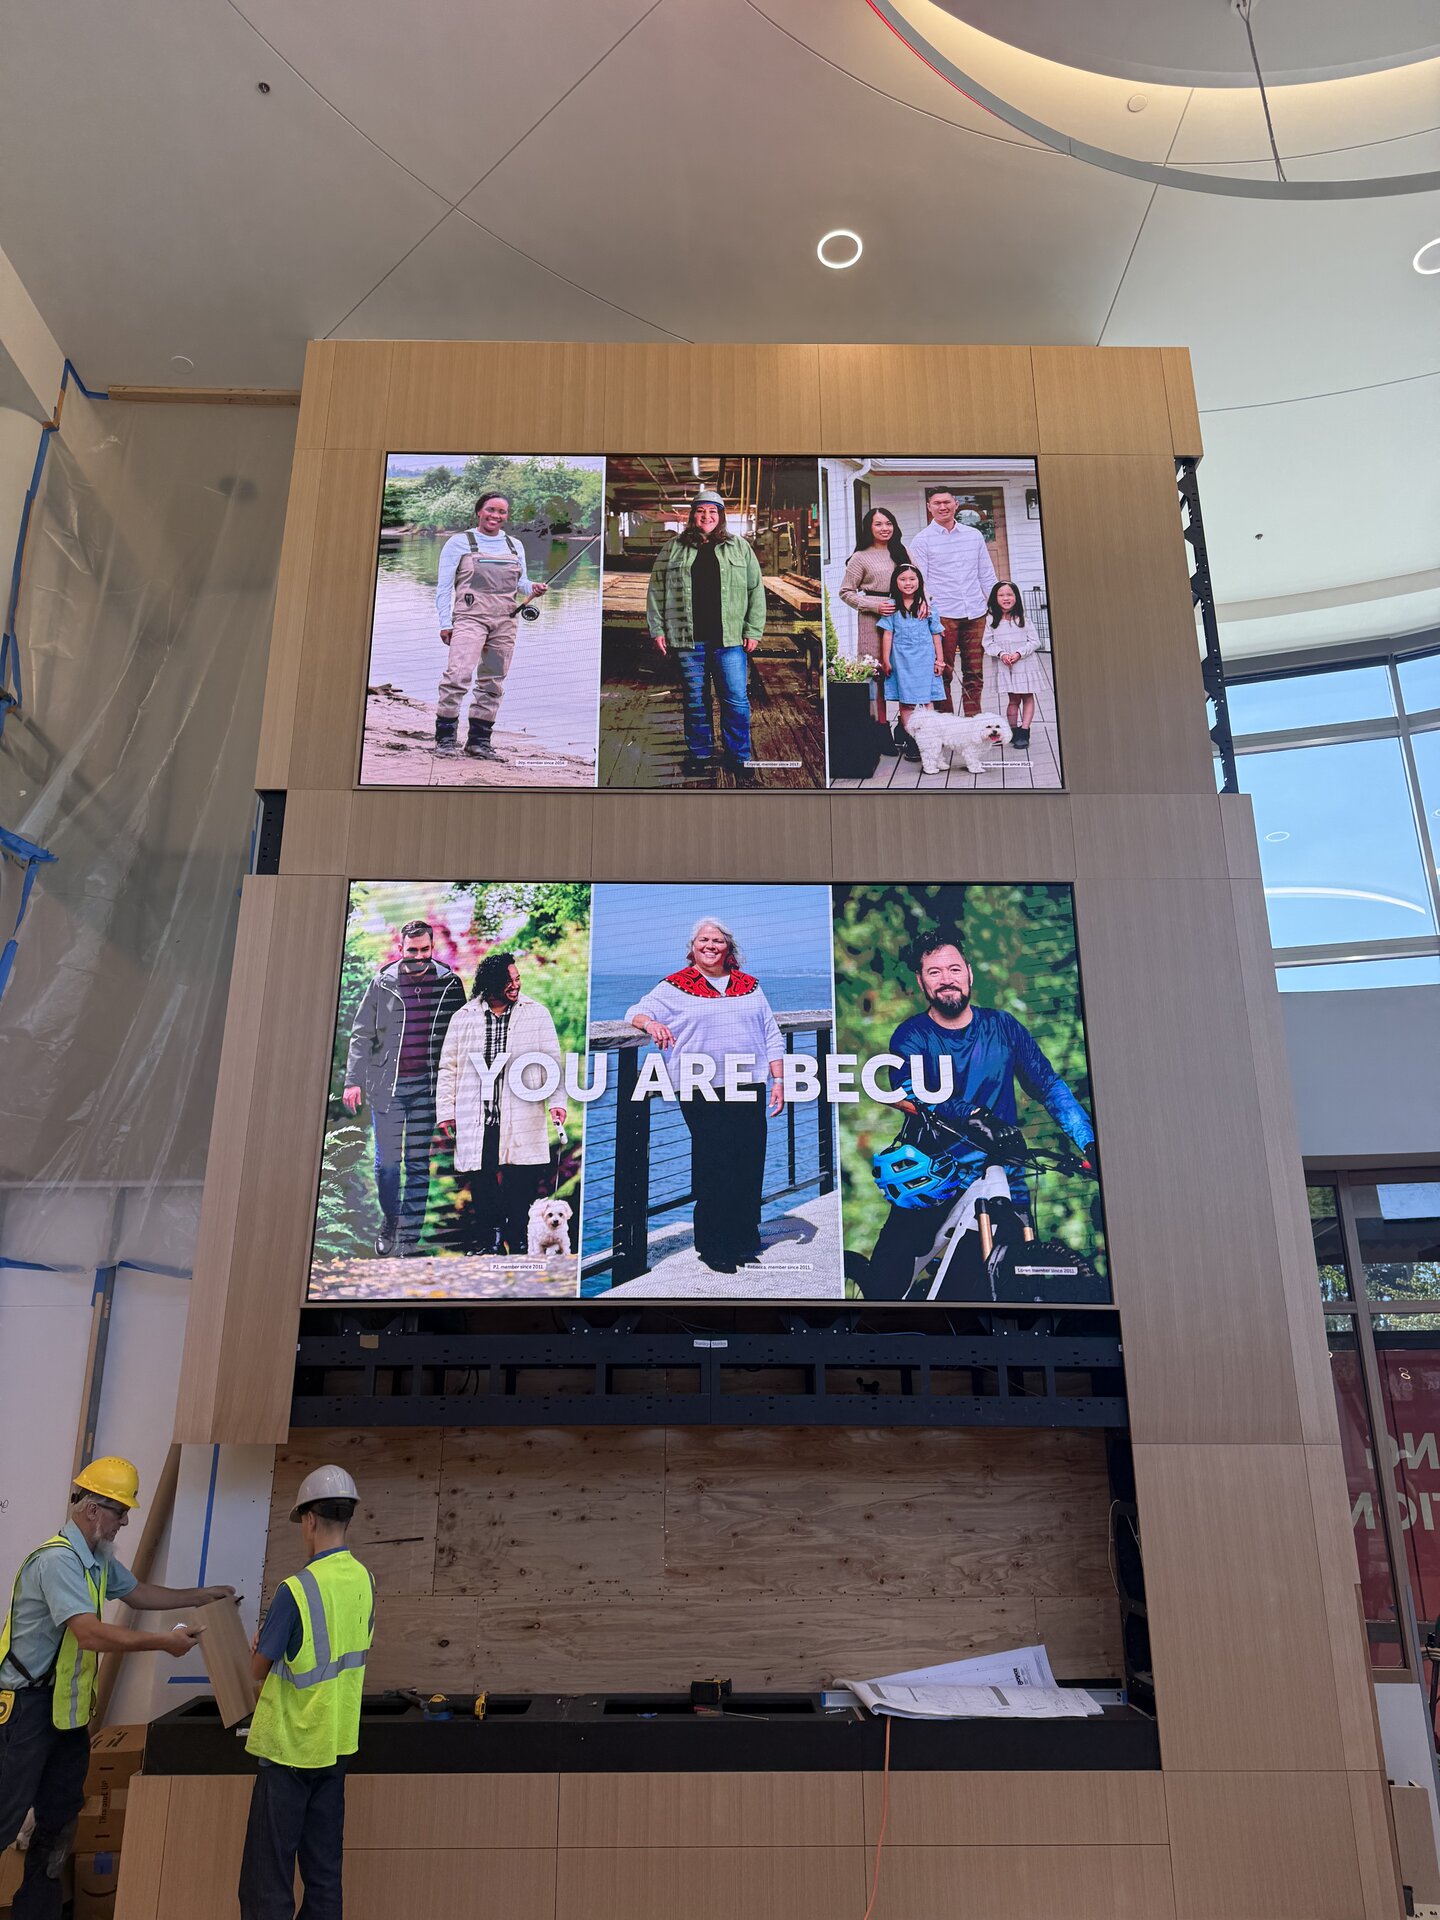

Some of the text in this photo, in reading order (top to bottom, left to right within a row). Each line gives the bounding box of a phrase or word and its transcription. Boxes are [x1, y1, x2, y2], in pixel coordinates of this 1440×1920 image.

[468, 1052, 954, 1104] YOU ARE BECU
